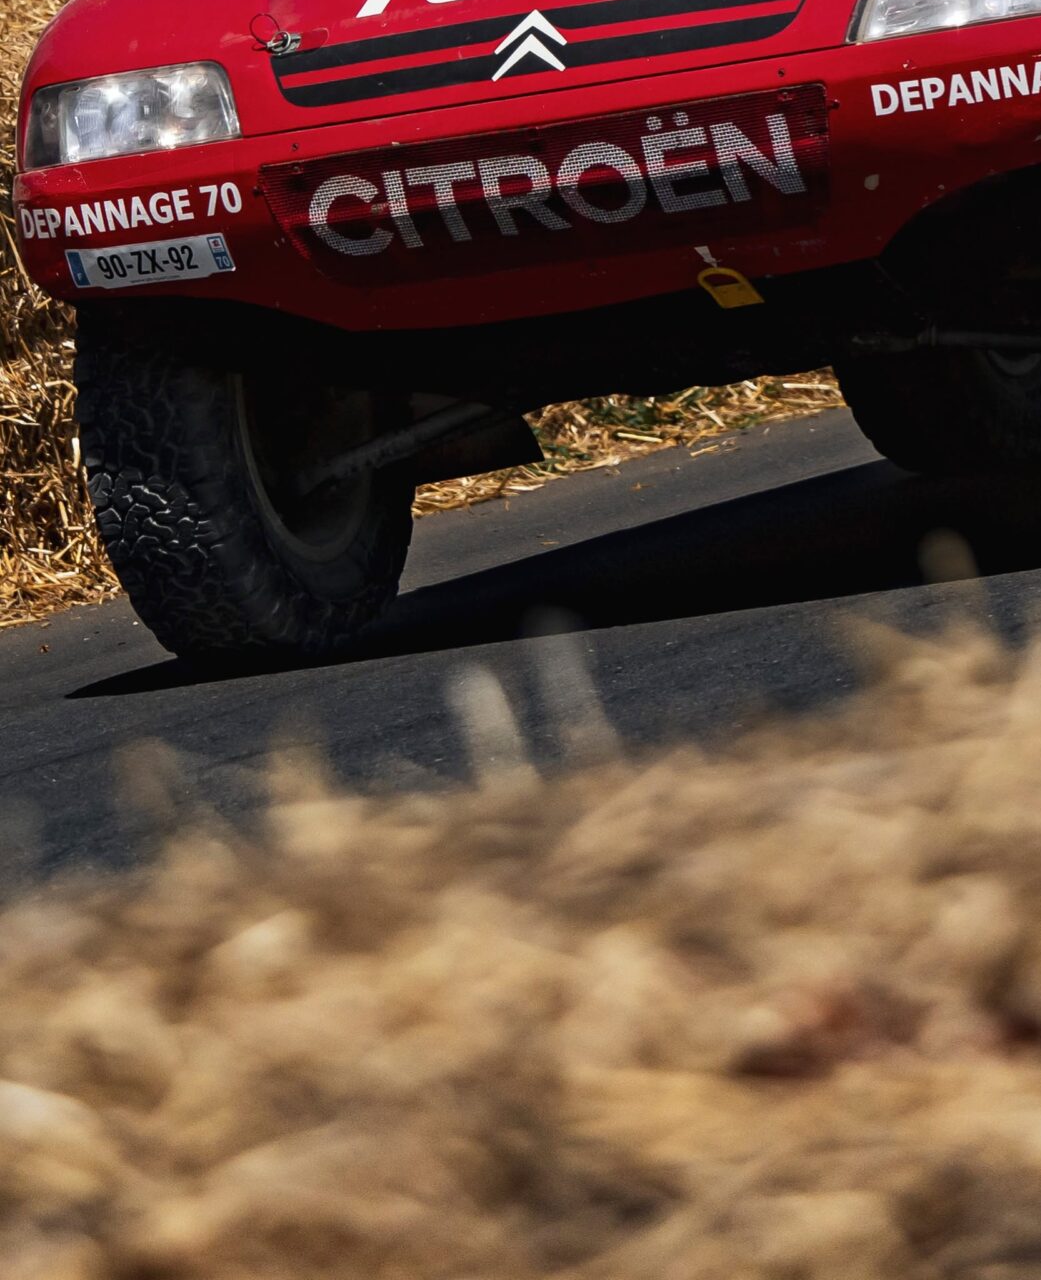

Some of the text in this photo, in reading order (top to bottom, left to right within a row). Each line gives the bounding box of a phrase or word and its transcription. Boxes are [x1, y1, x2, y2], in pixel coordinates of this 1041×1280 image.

[20, 182, 243, 239] DEPANNAGE 70
[308, 111, 808, 258] CITROËN
[97, 245, 199, 280] 90-ZX-92
[215, 255, 231, 268] 70
